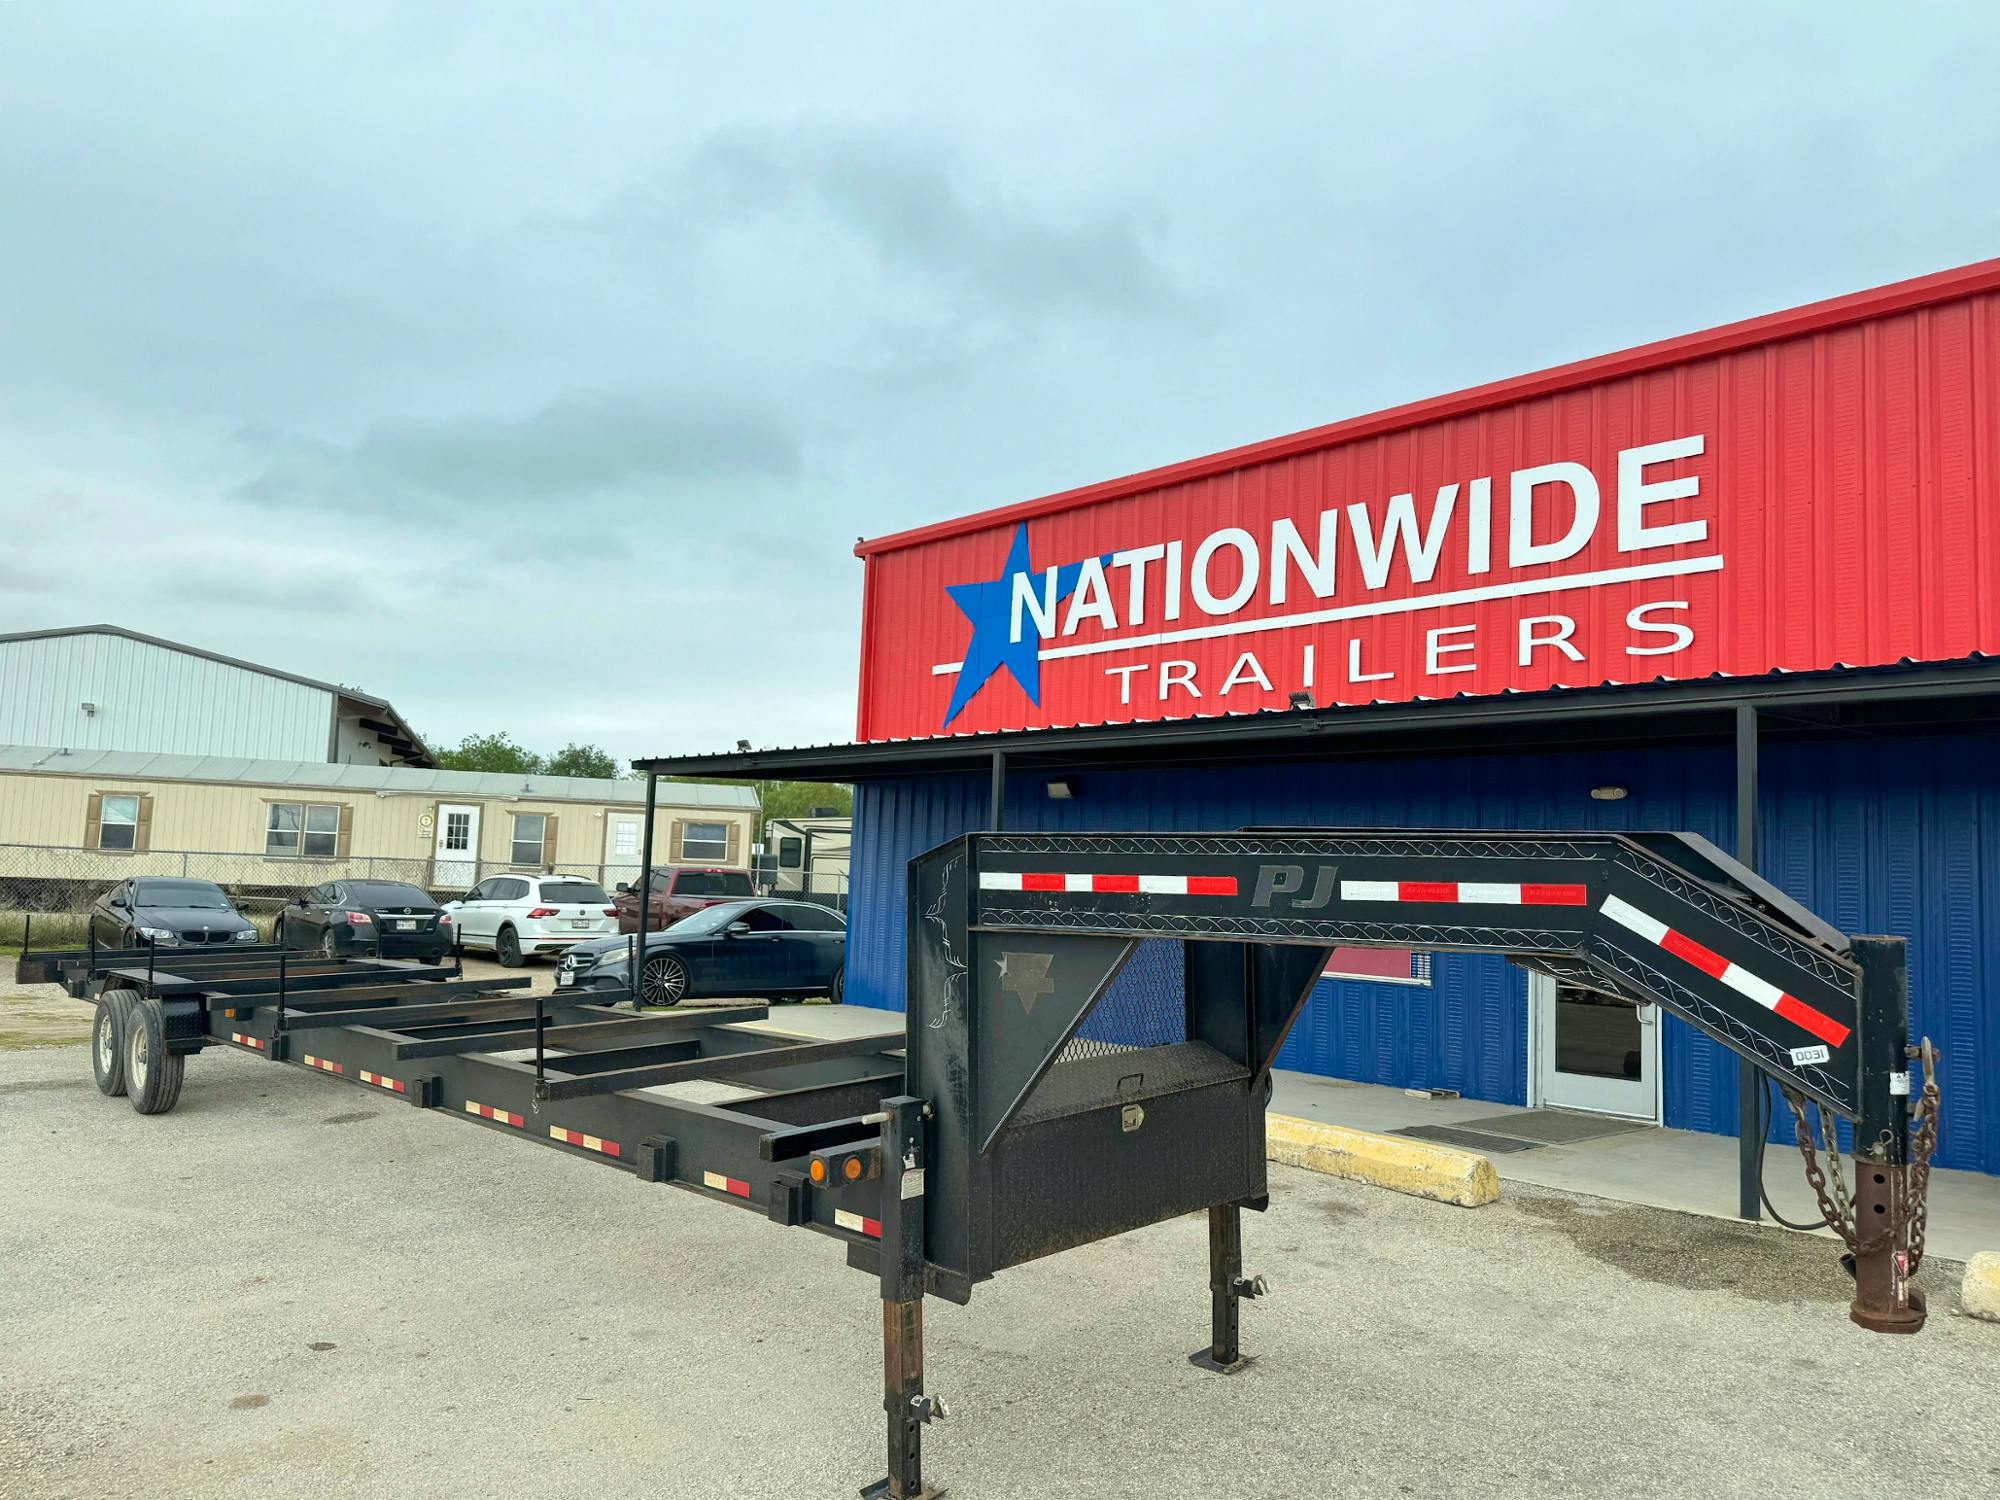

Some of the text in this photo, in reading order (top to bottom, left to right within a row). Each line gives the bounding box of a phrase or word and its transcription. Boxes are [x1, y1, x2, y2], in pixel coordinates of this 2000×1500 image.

[1010, 434, 1707, 644] NATIONWIDE
[1104, 601, 1694, 705] TRAILERS
[1250, 865, 1339, 909] PJ
